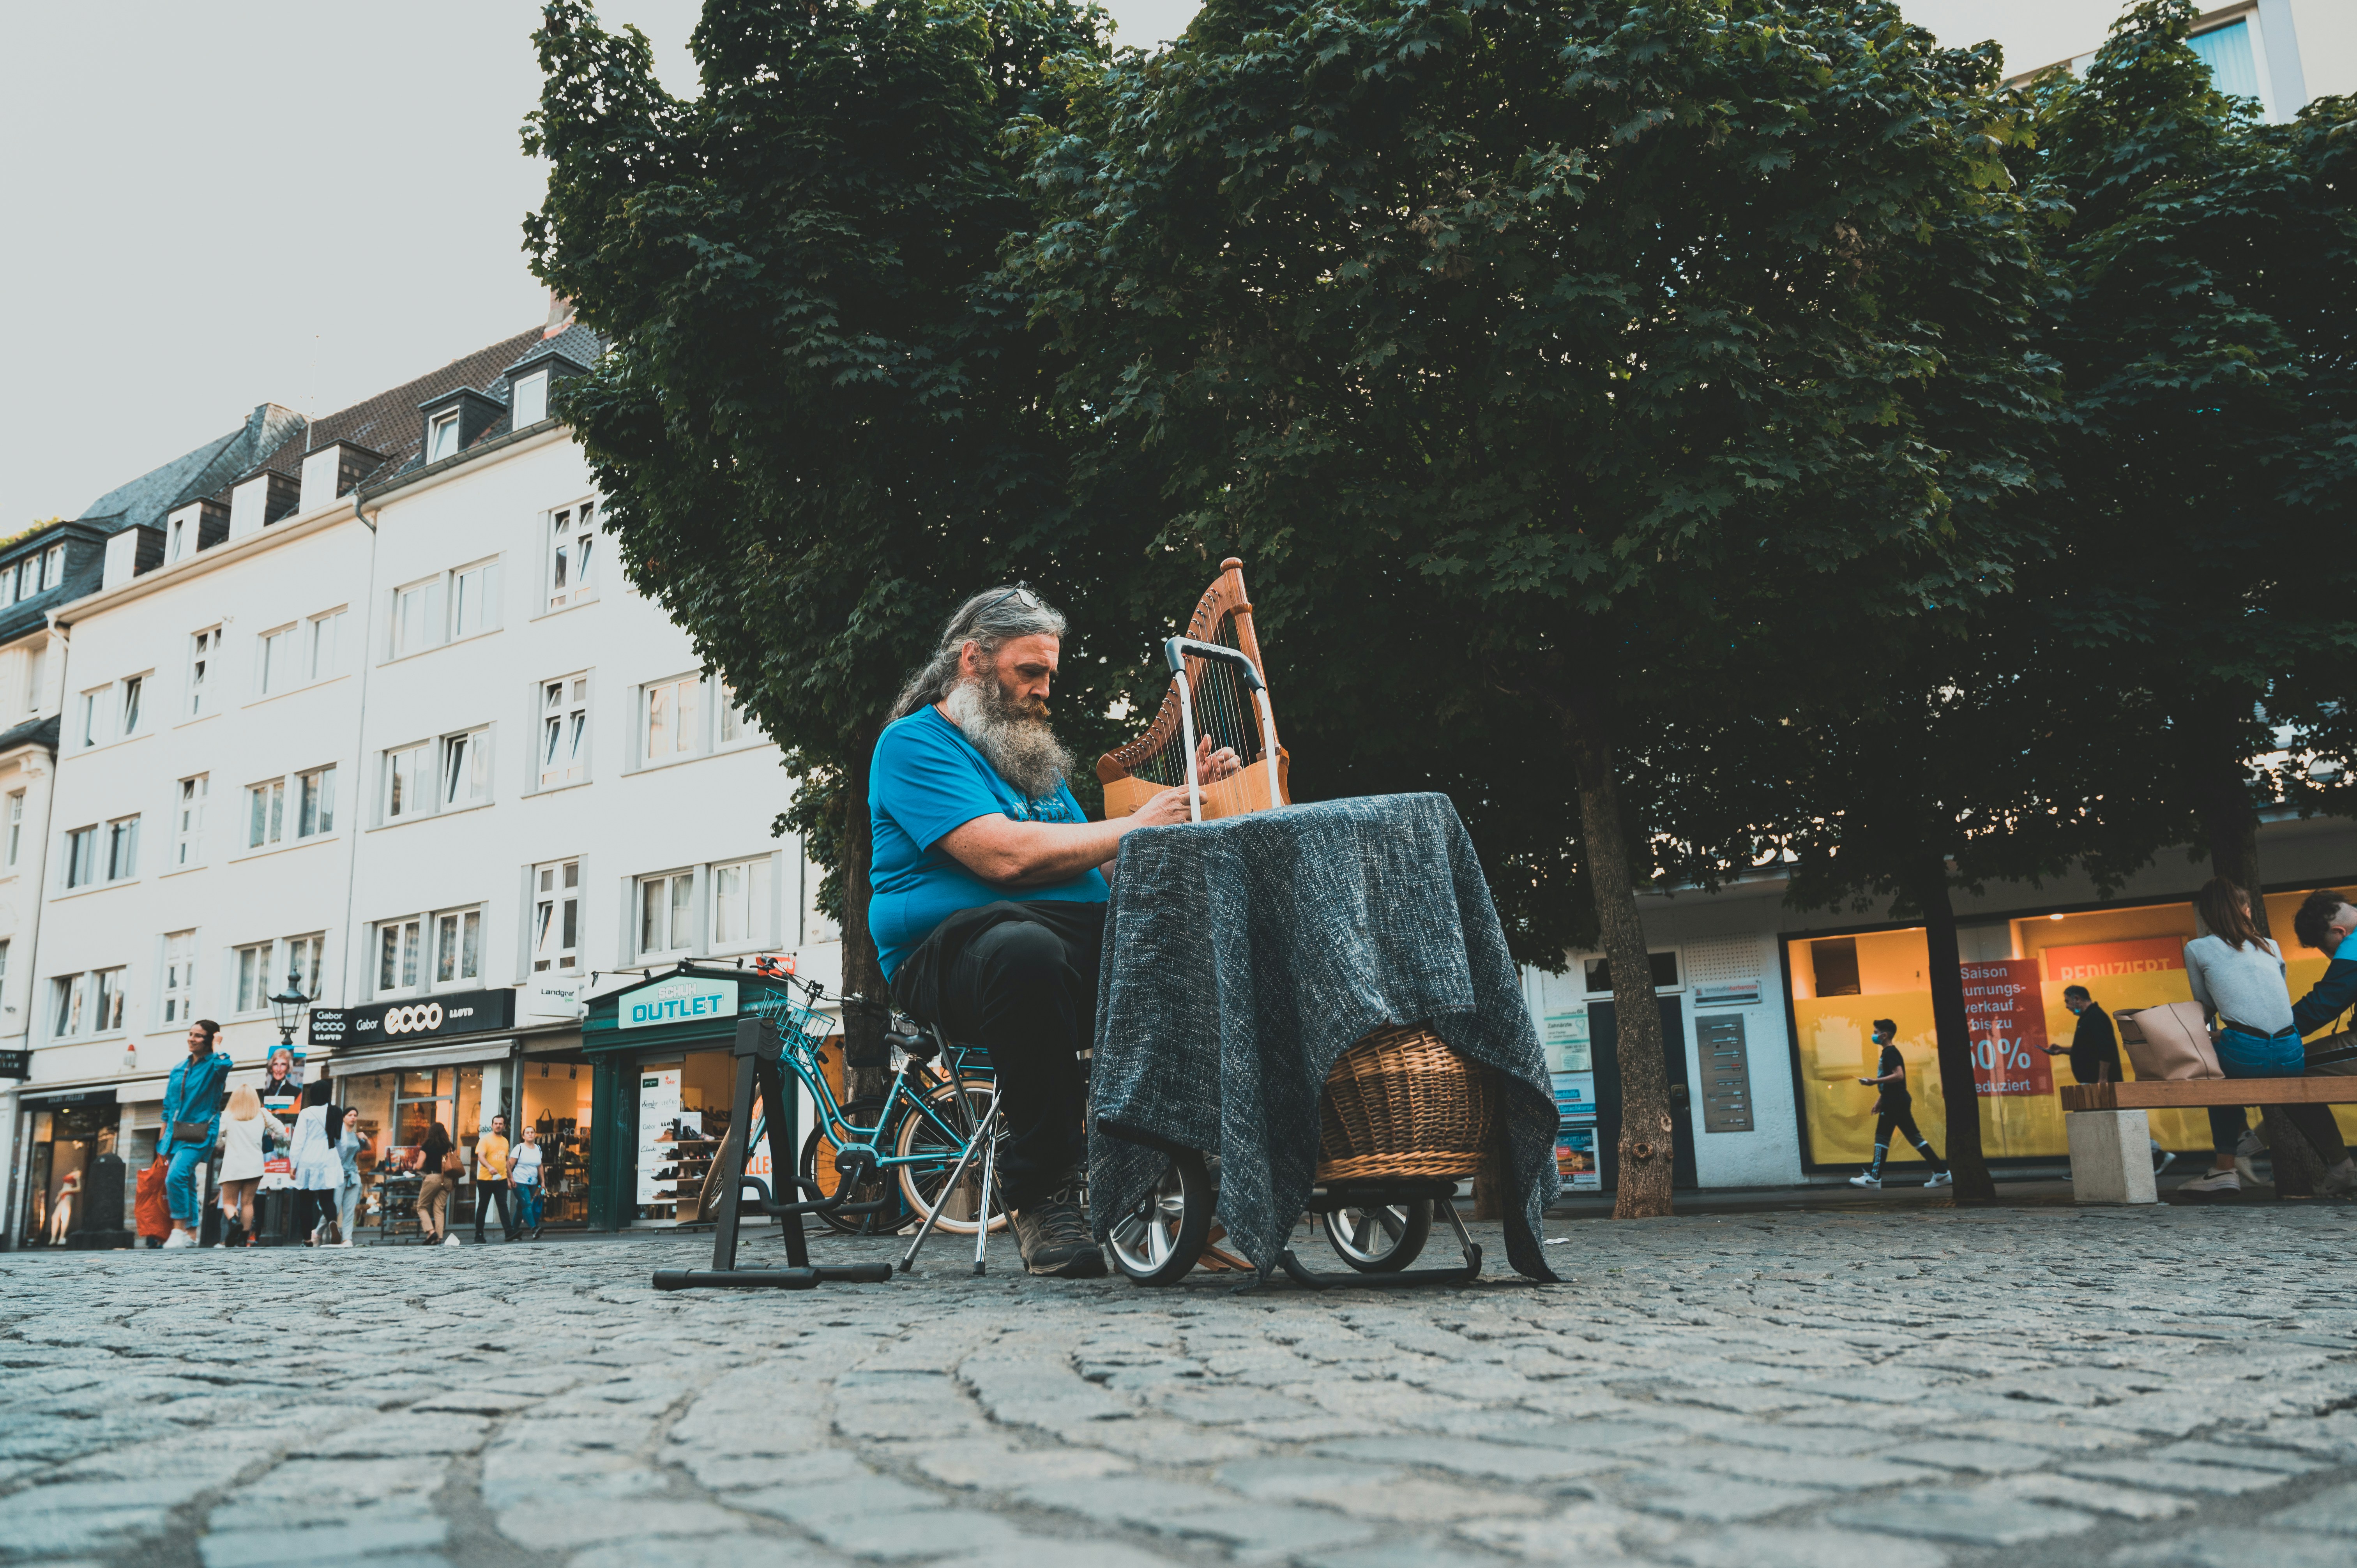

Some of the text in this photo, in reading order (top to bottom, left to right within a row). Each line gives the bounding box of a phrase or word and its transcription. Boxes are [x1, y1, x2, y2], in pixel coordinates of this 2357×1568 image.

[1961, 968, 2007, 980] Saison
[541, 989, 574, 997] Landgraf
[658, 982, 696, 999] SCHUH
[1963, 984, 2026, 997] umungs-
[631, 992, 724, 1024] OUTLET
[317, 1012, 343, 1020] Gabor
[356, 1003, 474, 1035] Gabor ecco LLOYD
[312, 1022, 346, 1032] ecco
[1972, 1019, 2012, 1030] bis zu
[1975, 1079, 2031, 1093] eduziert
[477, 1125, 493, 1133] Gabo
[745, 1156, 772, 1174] LLE
